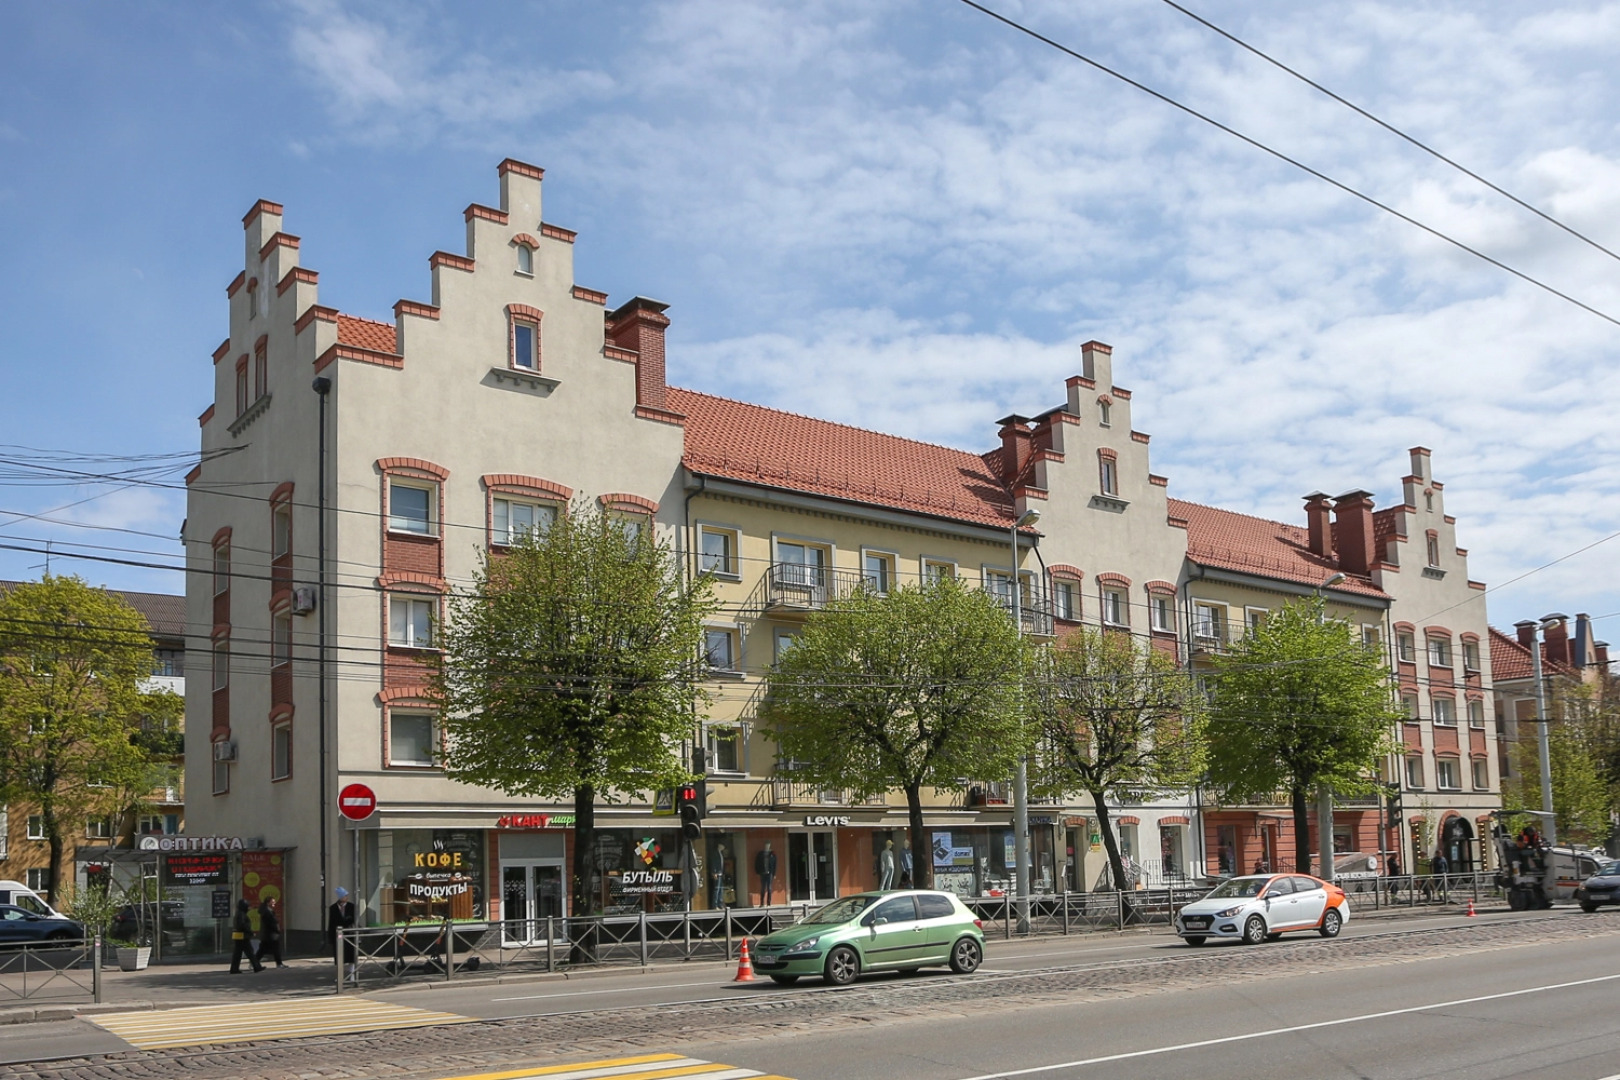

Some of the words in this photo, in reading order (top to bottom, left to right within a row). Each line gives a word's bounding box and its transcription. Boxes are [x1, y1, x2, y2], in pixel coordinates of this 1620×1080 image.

[511, 814, 548, 827] КАНТ
[159, 837, 243, 850] ОПТИКА
[414, 852, 462, 867] КОФЕ
[622, 870, 673, 884] БУТЫЛЬ
[409, 881, 468, 898] ПРОДУКТЫ
